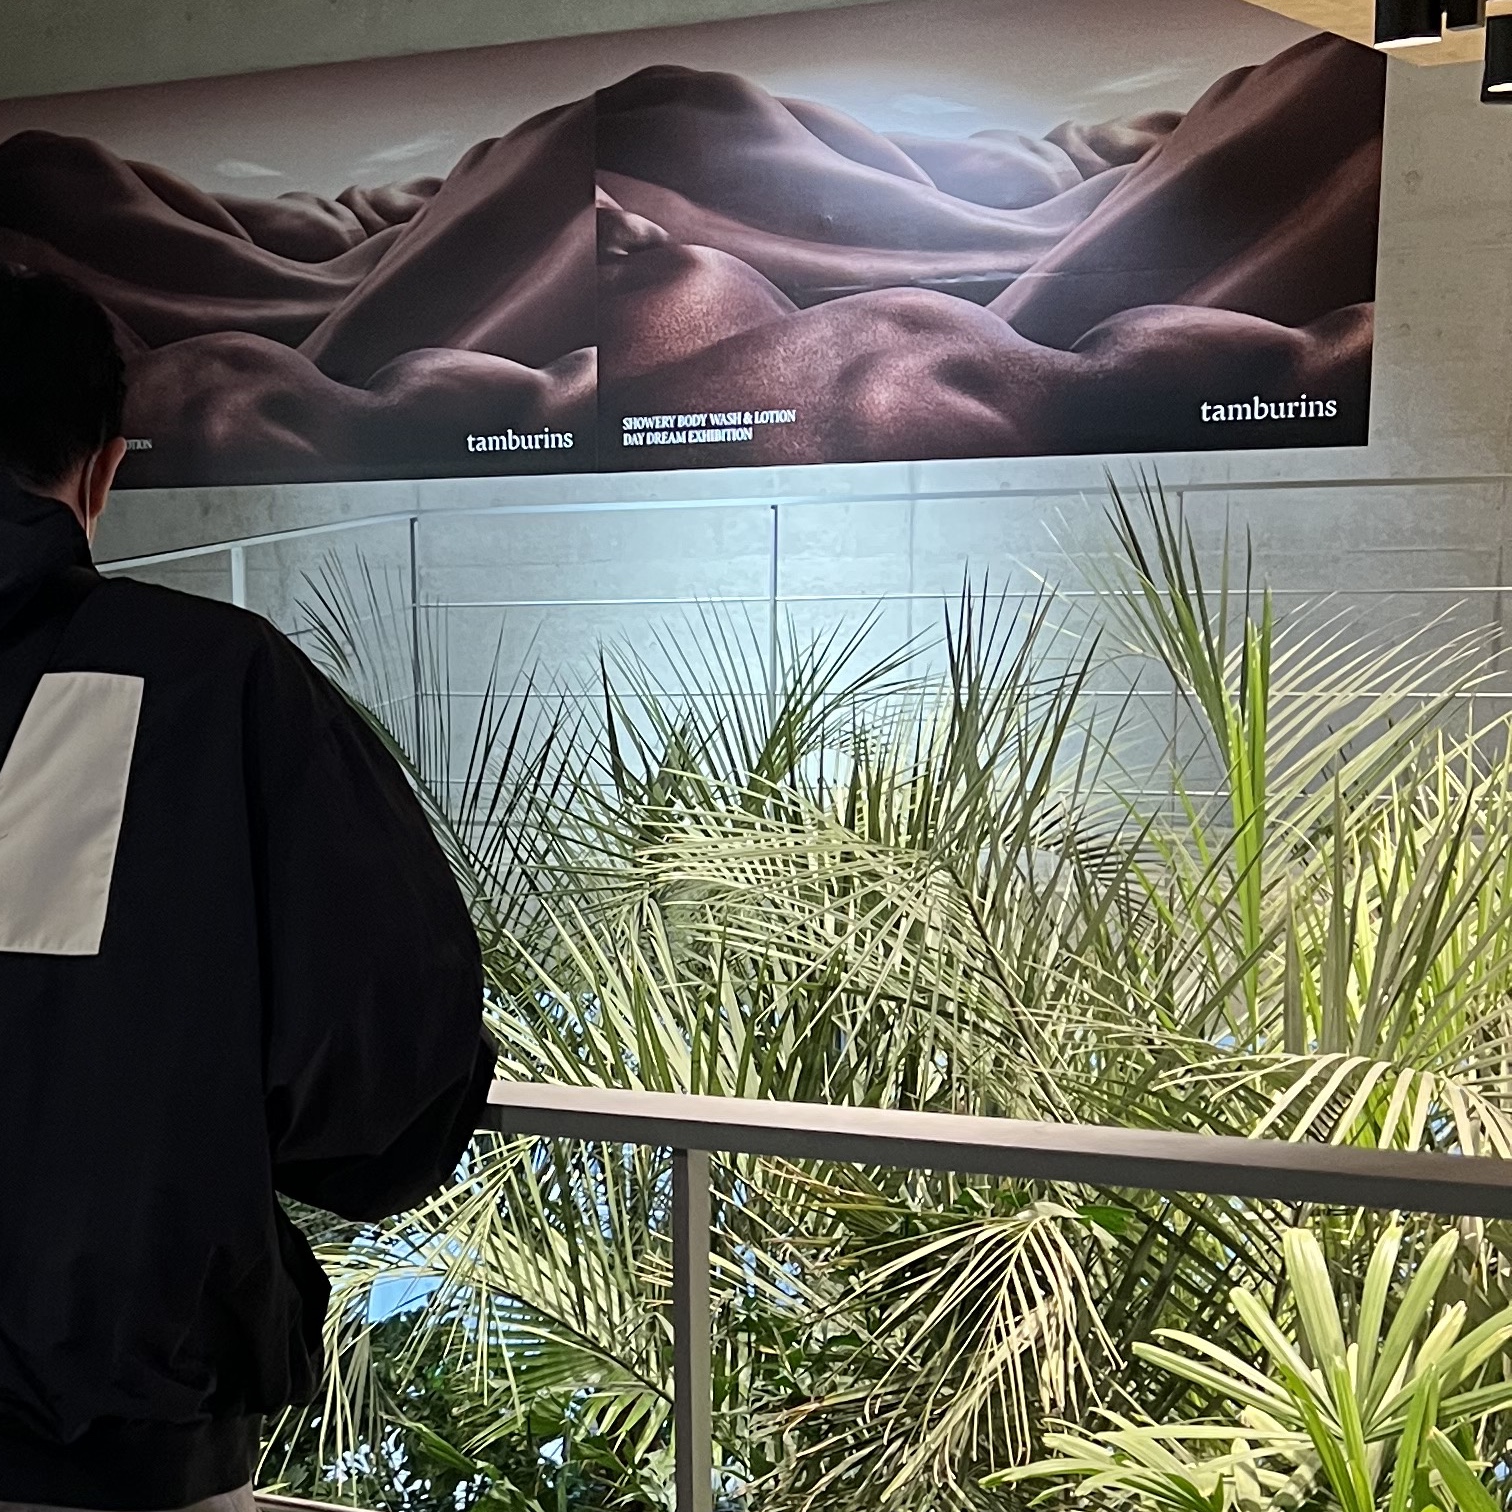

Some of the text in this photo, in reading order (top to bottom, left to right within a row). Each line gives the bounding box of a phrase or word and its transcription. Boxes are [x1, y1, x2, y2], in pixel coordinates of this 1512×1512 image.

[1201, 393, 1337, 422] tamburins
[622, 409, 797, 431] SHOWERY BODY WASH & LOTION
[466, 427, 574, 452] tamburins
[623, 427, 754, 446] DAY DREAM EXHIBITION
